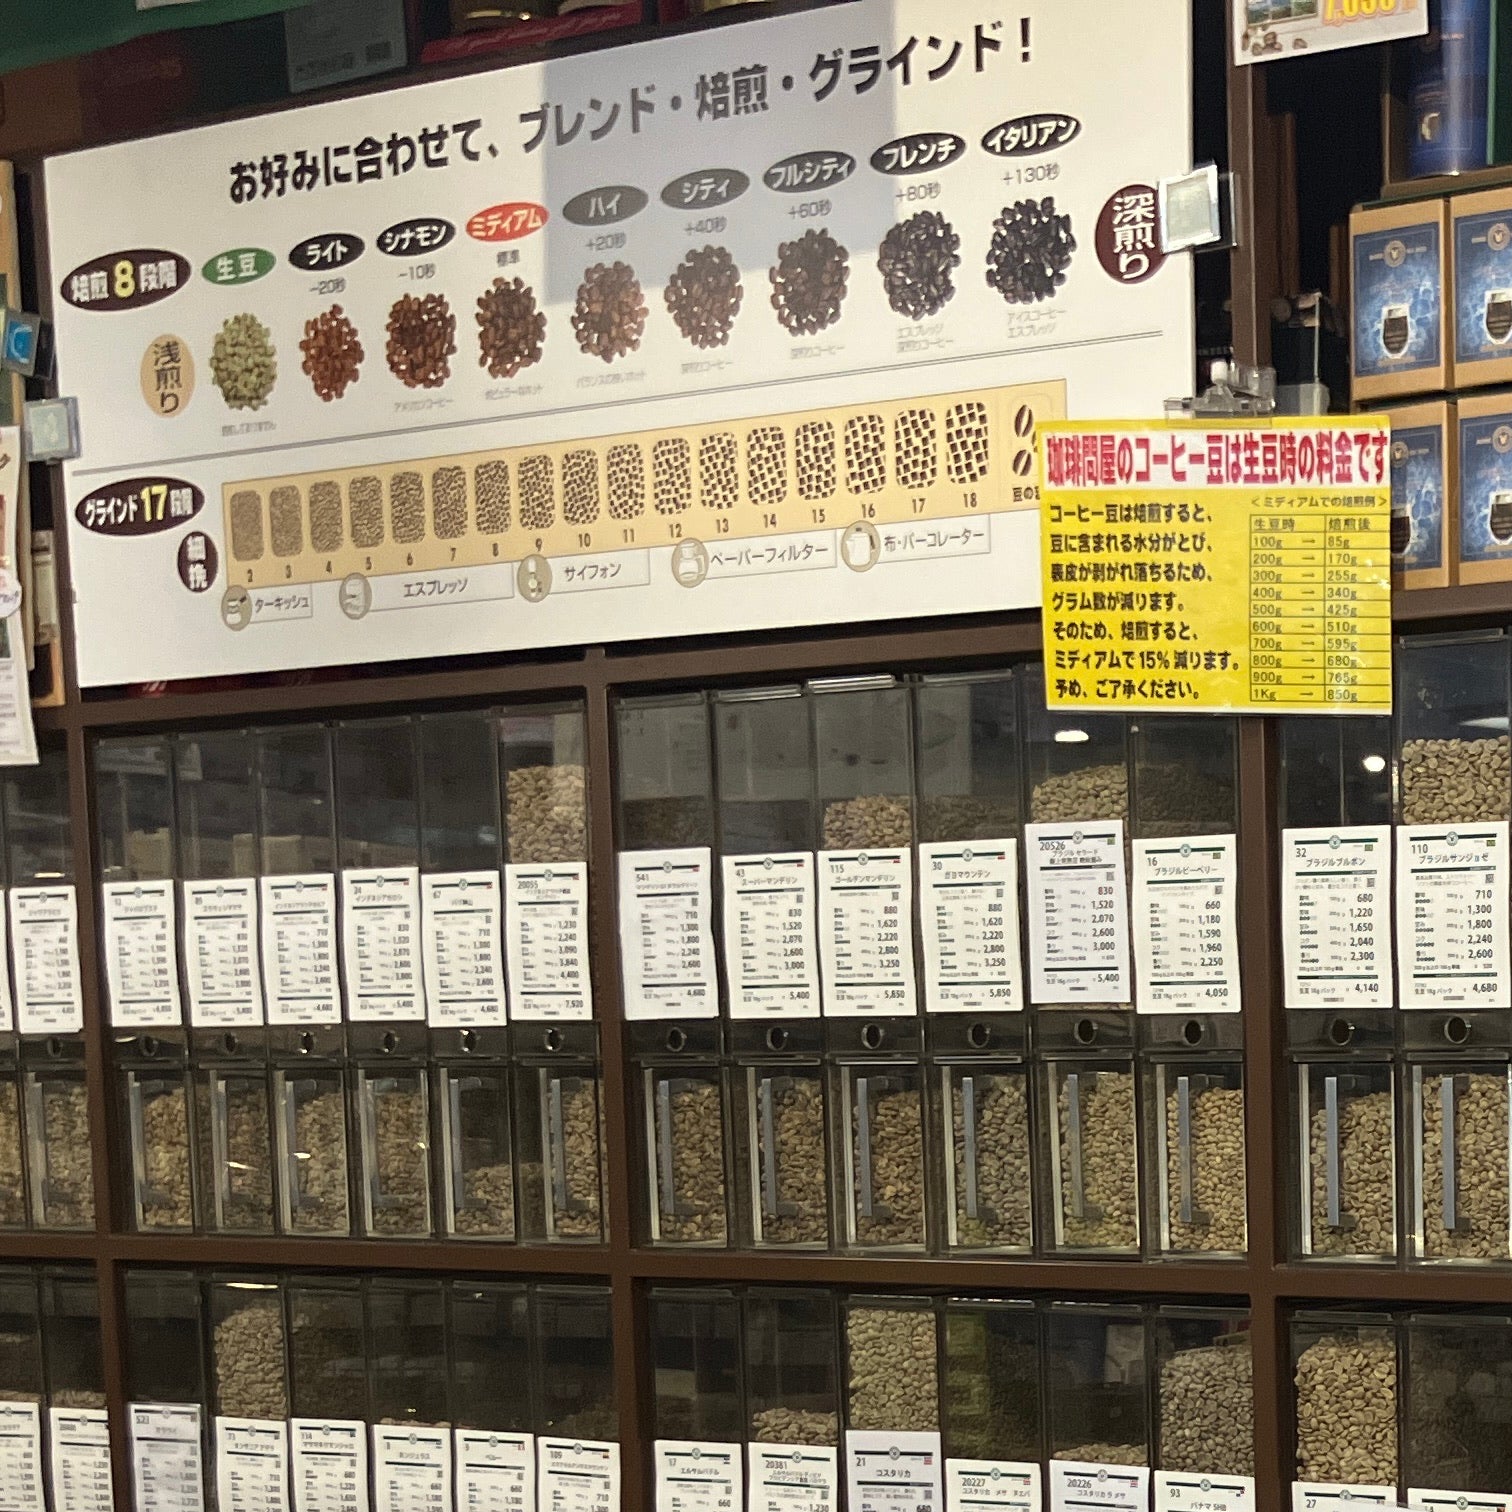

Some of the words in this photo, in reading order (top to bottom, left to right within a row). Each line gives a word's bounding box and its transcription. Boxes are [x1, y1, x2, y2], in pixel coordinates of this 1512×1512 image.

[988, 118, 1076, 151] イタリアン
[883, 140, 958, 170] フレンチ
[770, 159, 850, 186] フルシティ
[682, 177, 731, 201] シティ
[589, 194, 621, 217] ハイ
[471, 207, 543, 238] ミディアム
[384, 224, 446, 251] シナモン
[1112, 195, 1156, 280] 深煎り
[306, 238, 348, 265] ライト
[216, 254, 258, 280] 生豆
[152, 341, 181, 414] 浅煎り
[861, 502, 877, 518] 16
[912, 497, 926, 513] 17
[963, 491, 978, 508] 18
[668, 524, 682, 539] 12
[763, 513, 778, 528] 14
[578, 534, 591, 548] 10
[1254, 537, 1282, 548] 100g
[1328, 536, 1350, 548] 85g
[1253, 604, 1282, 617] 500g
[1327, 603, 1358, 617] 425g
[1254, 688, 1276, 702] 1Kg
[1327, 689, 1358, 702] 850g
